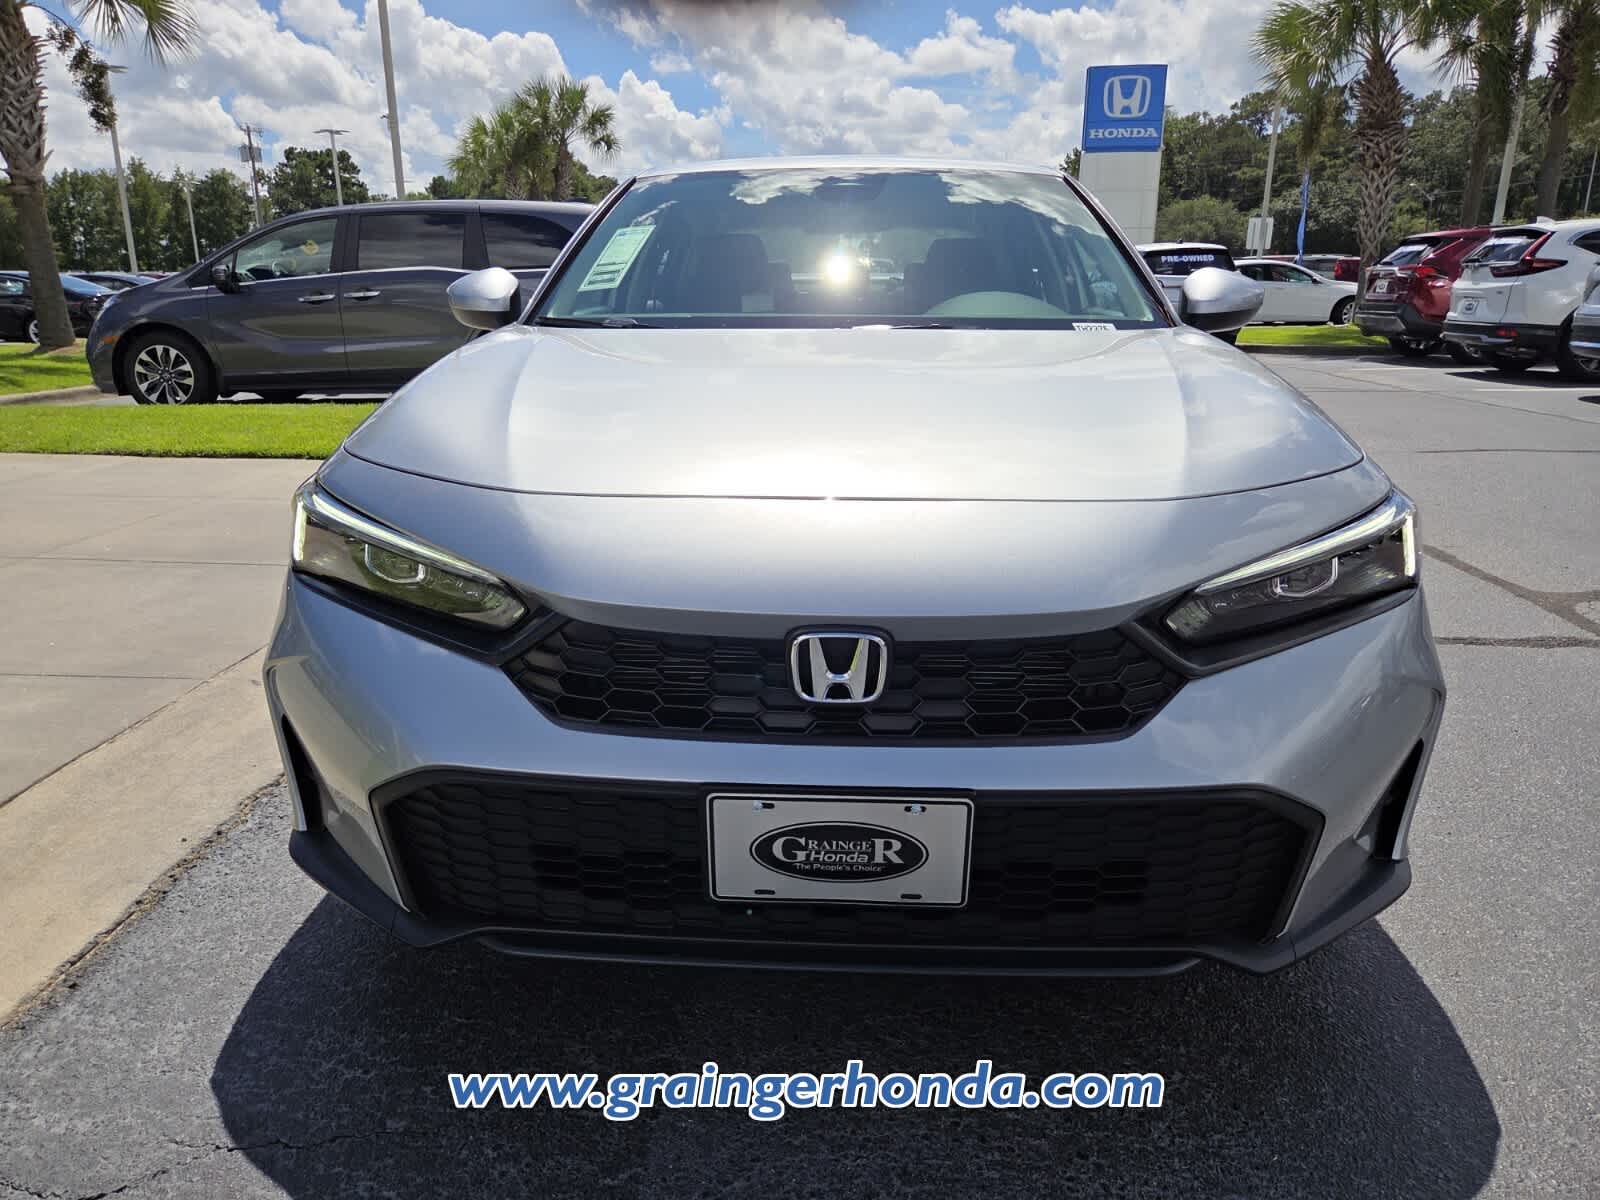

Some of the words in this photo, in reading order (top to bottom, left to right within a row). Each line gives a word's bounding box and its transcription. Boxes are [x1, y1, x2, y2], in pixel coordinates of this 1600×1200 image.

[1088, 128, 1159, 139] HONDA
[1161, 254, 1215, 263] PRE-OWNED
[772, 836, 904, 864] GRAINGER
[809, 850, 870, 863] Honda
[794, 863, 812, 871] The
[813, 863, 851, 872] People's
[853, 864, 883, 872] Choice
